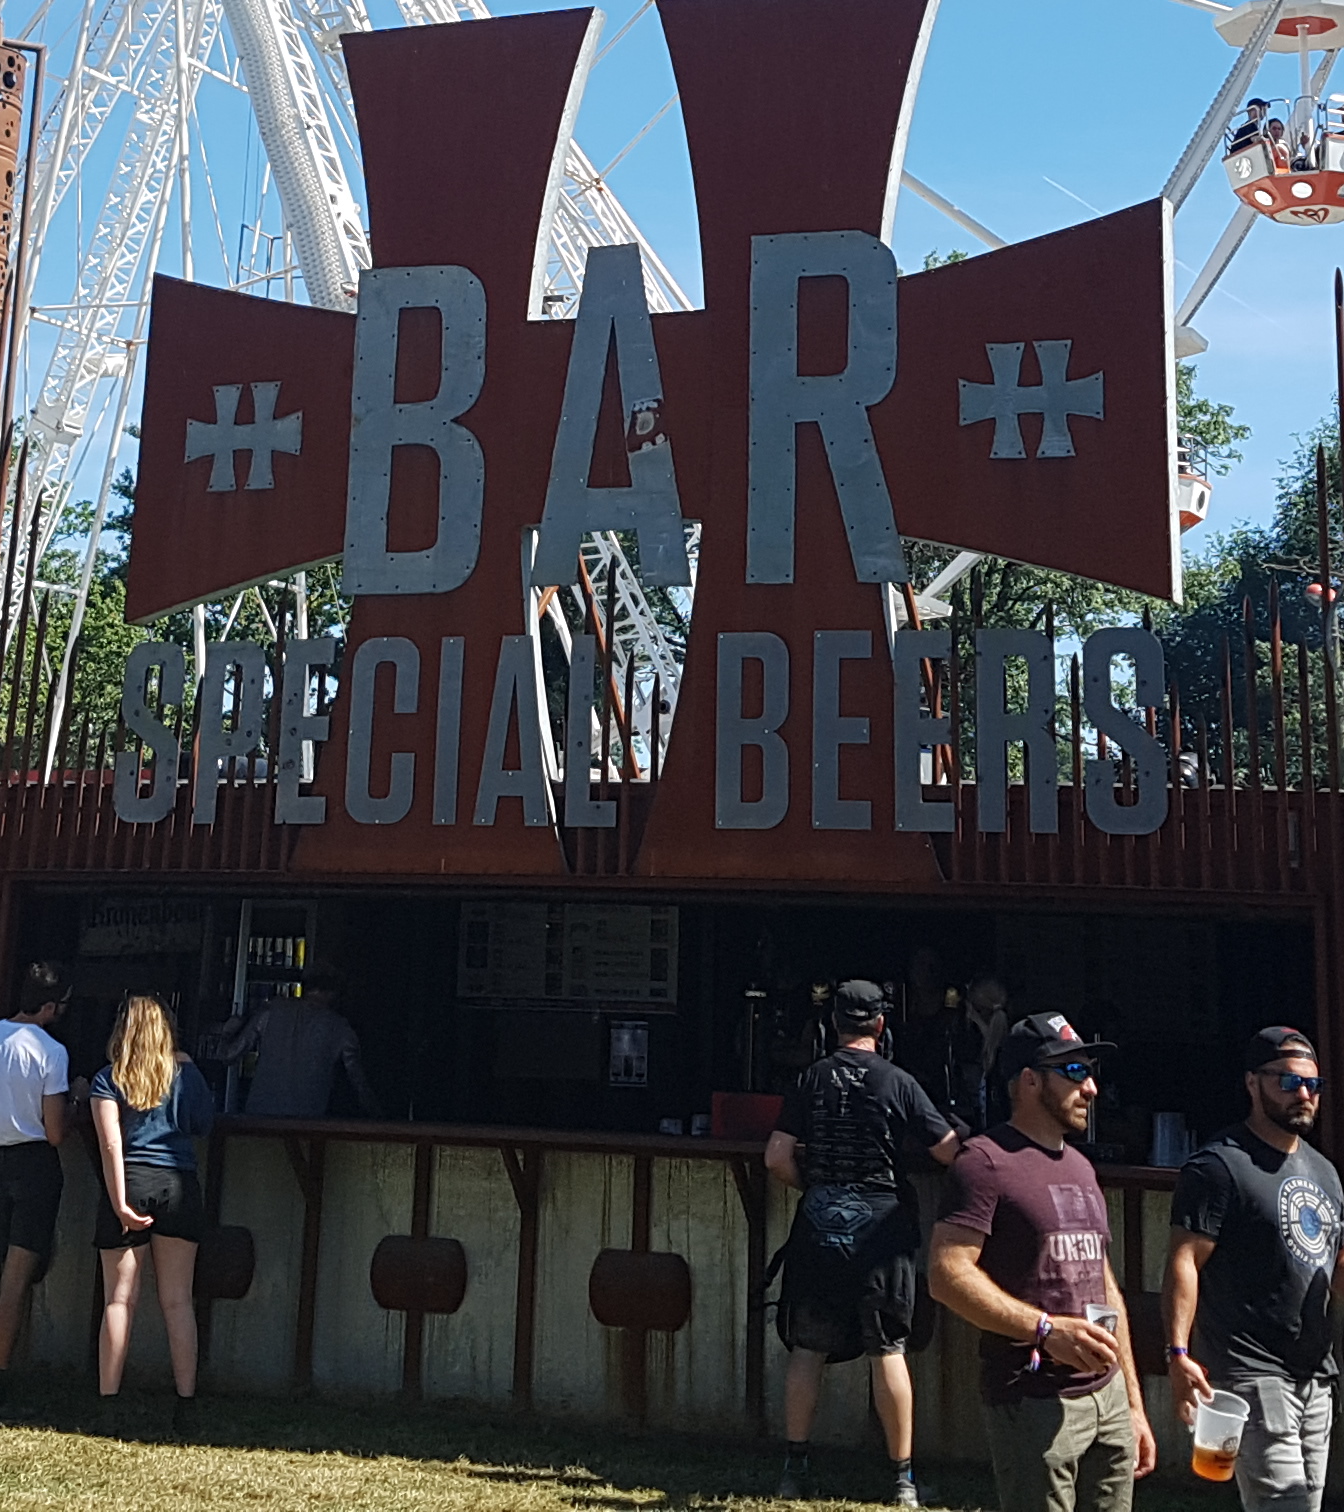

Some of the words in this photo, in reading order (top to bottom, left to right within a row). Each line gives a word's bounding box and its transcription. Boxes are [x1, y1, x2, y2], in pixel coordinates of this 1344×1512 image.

[342, 231, 907, 593] BAR
[113, 633, 620, 828] SPECIAL
[714, 626, 1171, 835] BEERS
[1280, 1197, 1290, 1237] TESTED
[1284, 1179, 1319, 1194] ELEMENT
